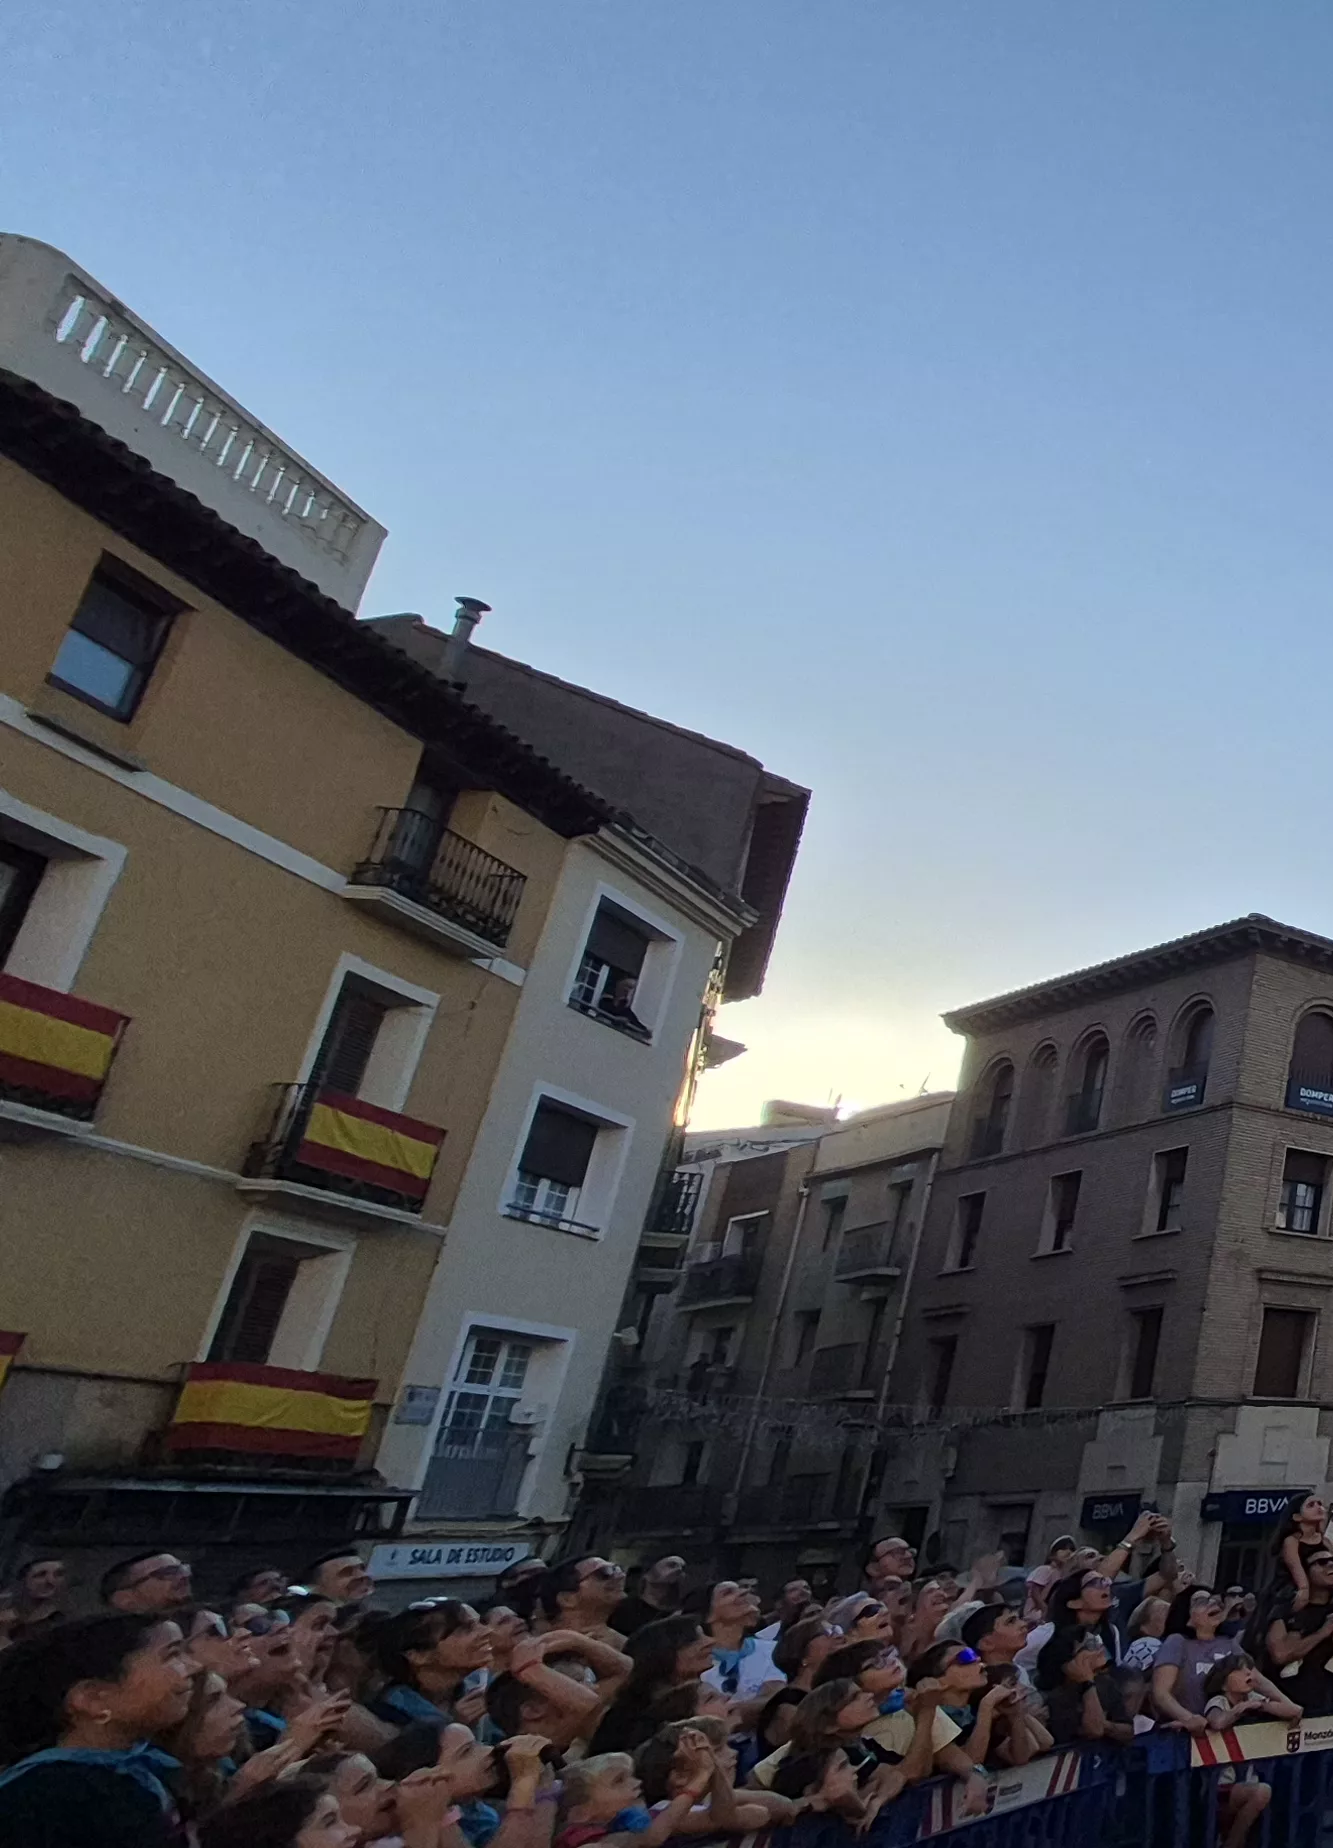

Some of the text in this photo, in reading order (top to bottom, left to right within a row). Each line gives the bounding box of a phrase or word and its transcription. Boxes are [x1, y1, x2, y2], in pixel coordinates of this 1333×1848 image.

[1091, 1501, 1125, 1520] BBVA
[1244, 1496, 1289, 1515] BBVA
[408, 1547, 515, 1565] SALA DE ESTUDIO
